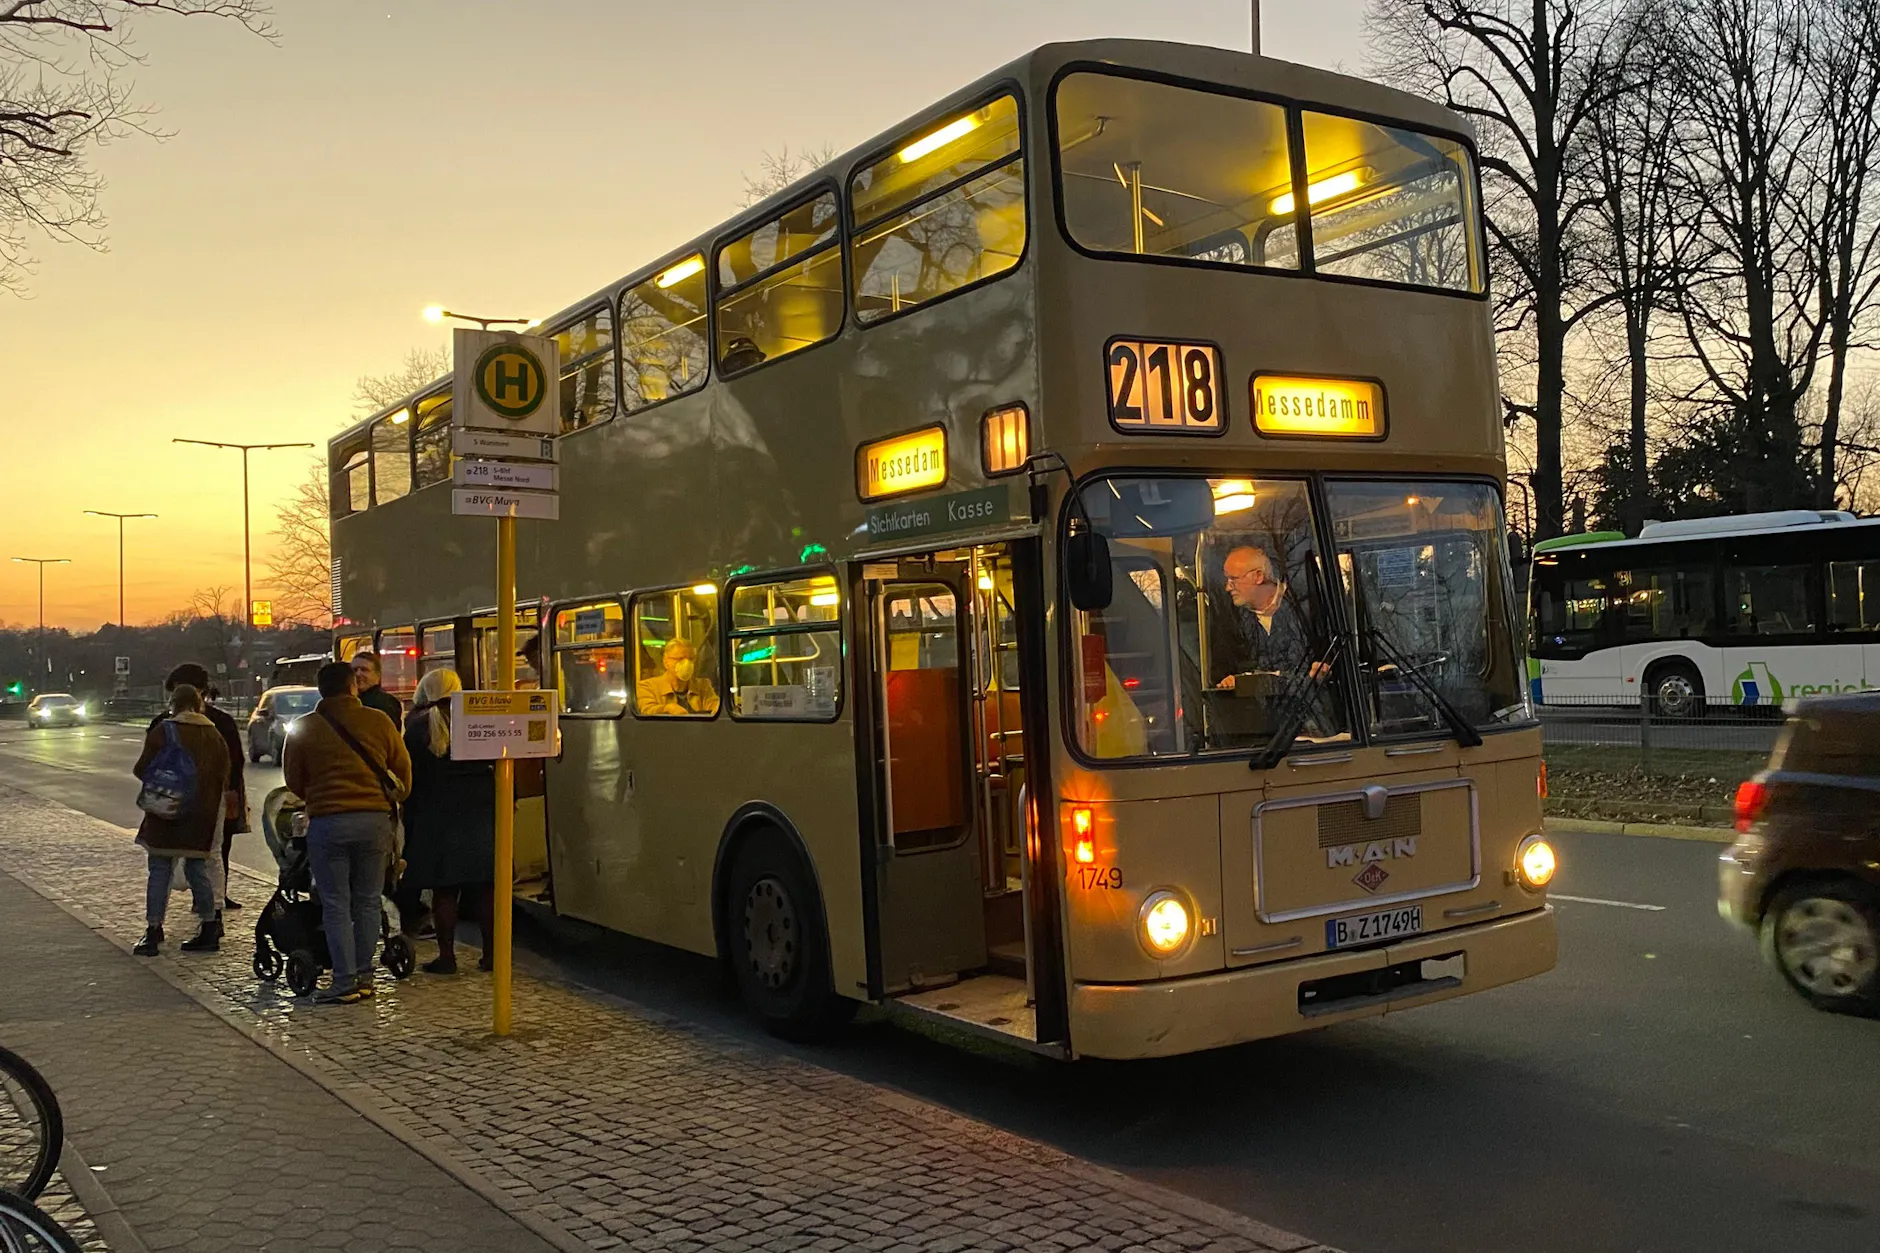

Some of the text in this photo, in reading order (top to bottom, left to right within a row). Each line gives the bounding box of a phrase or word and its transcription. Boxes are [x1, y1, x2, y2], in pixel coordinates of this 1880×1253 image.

[496, 360, 528, 402] H
[1111, 345, 1213, 423] 218
[473, 466, 489, 476] 218
[472, 495, 493, 505] BVG
[870, 500, 994, 534] Sichtkarten Kasse
[468, 696, 487, 705] BVG
[1077, 867, 1123, 889] 1749
